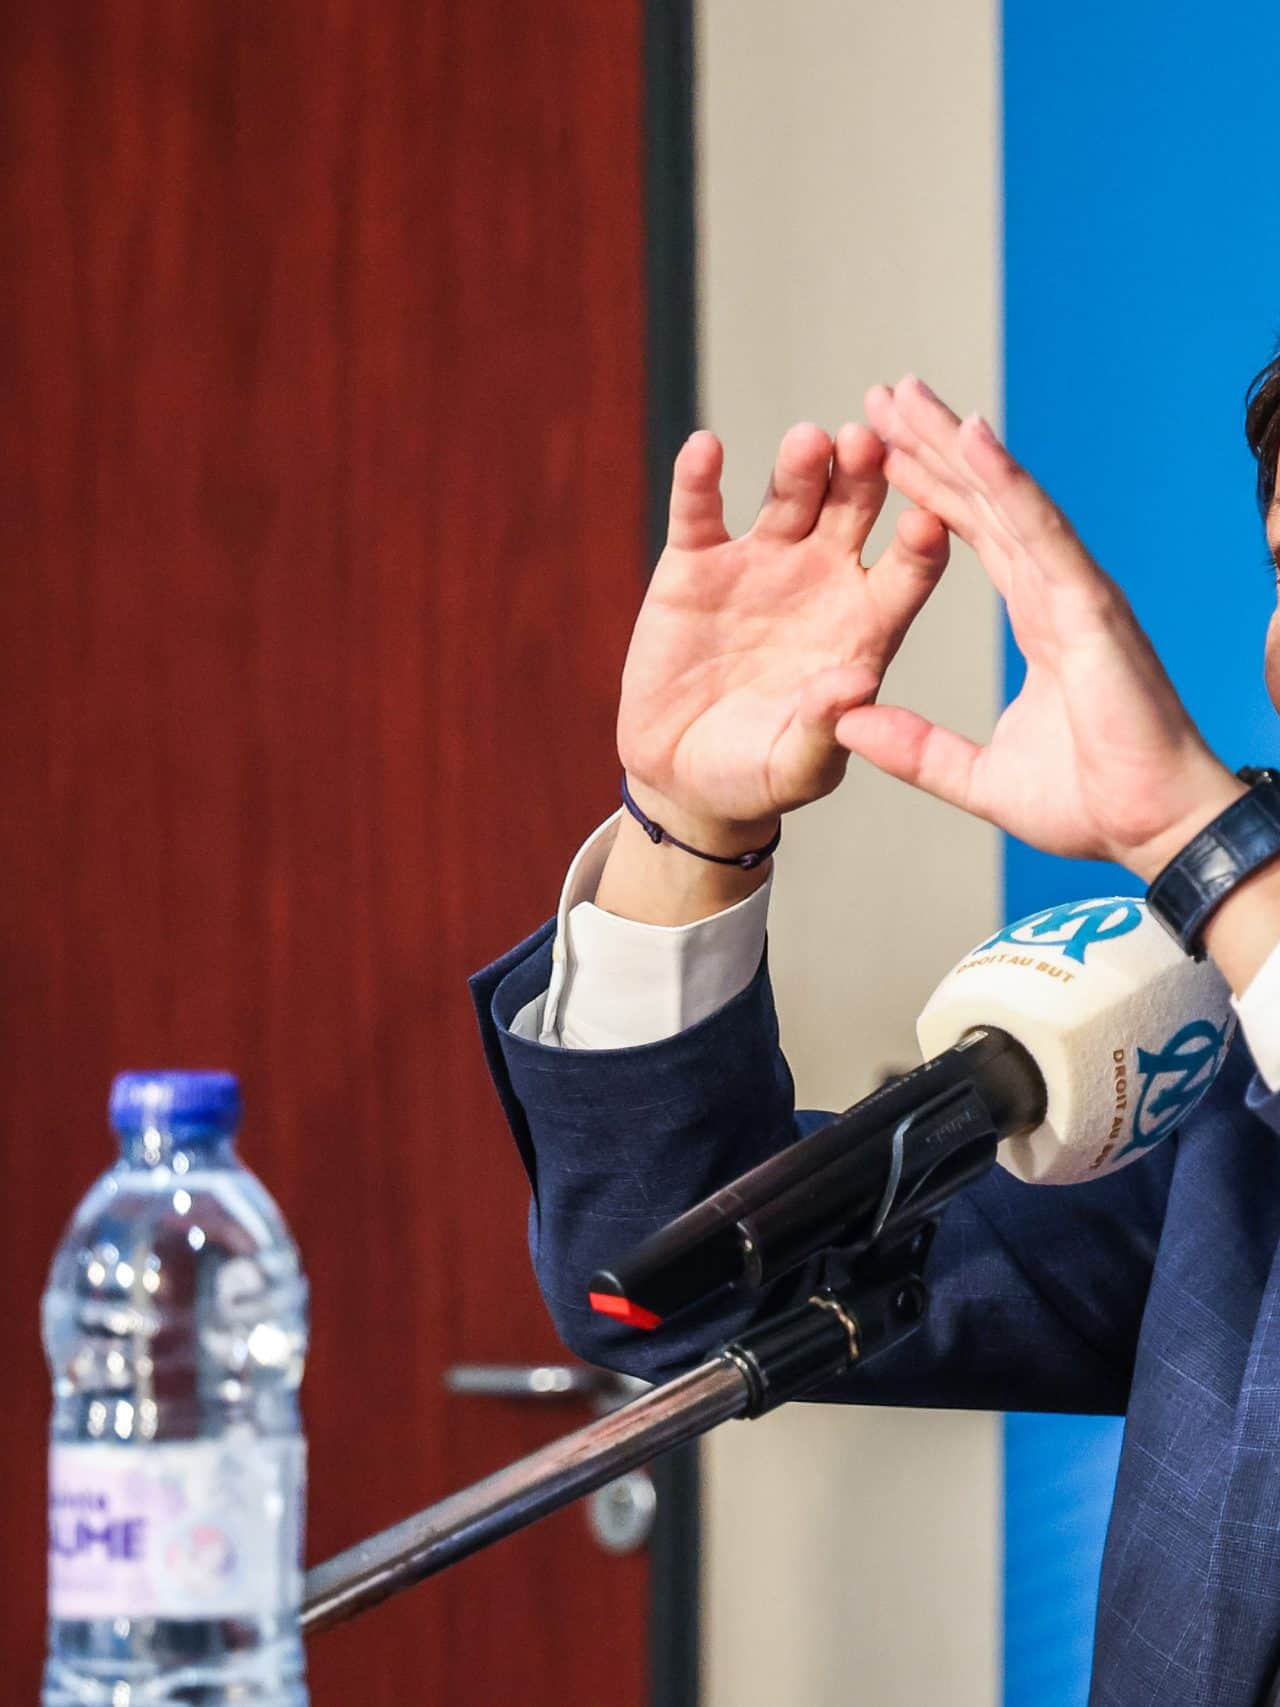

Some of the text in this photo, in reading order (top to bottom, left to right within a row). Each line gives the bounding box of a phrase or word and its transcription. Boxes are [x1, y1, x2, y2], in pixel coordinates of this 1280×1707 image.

[1009, 955, 1034, 966] AU
[1036, 961, 1074, 983] BUT
[1113, 1049, 1127, 1111] DROIT
[1109, 1116, 1123, 1140] AU
